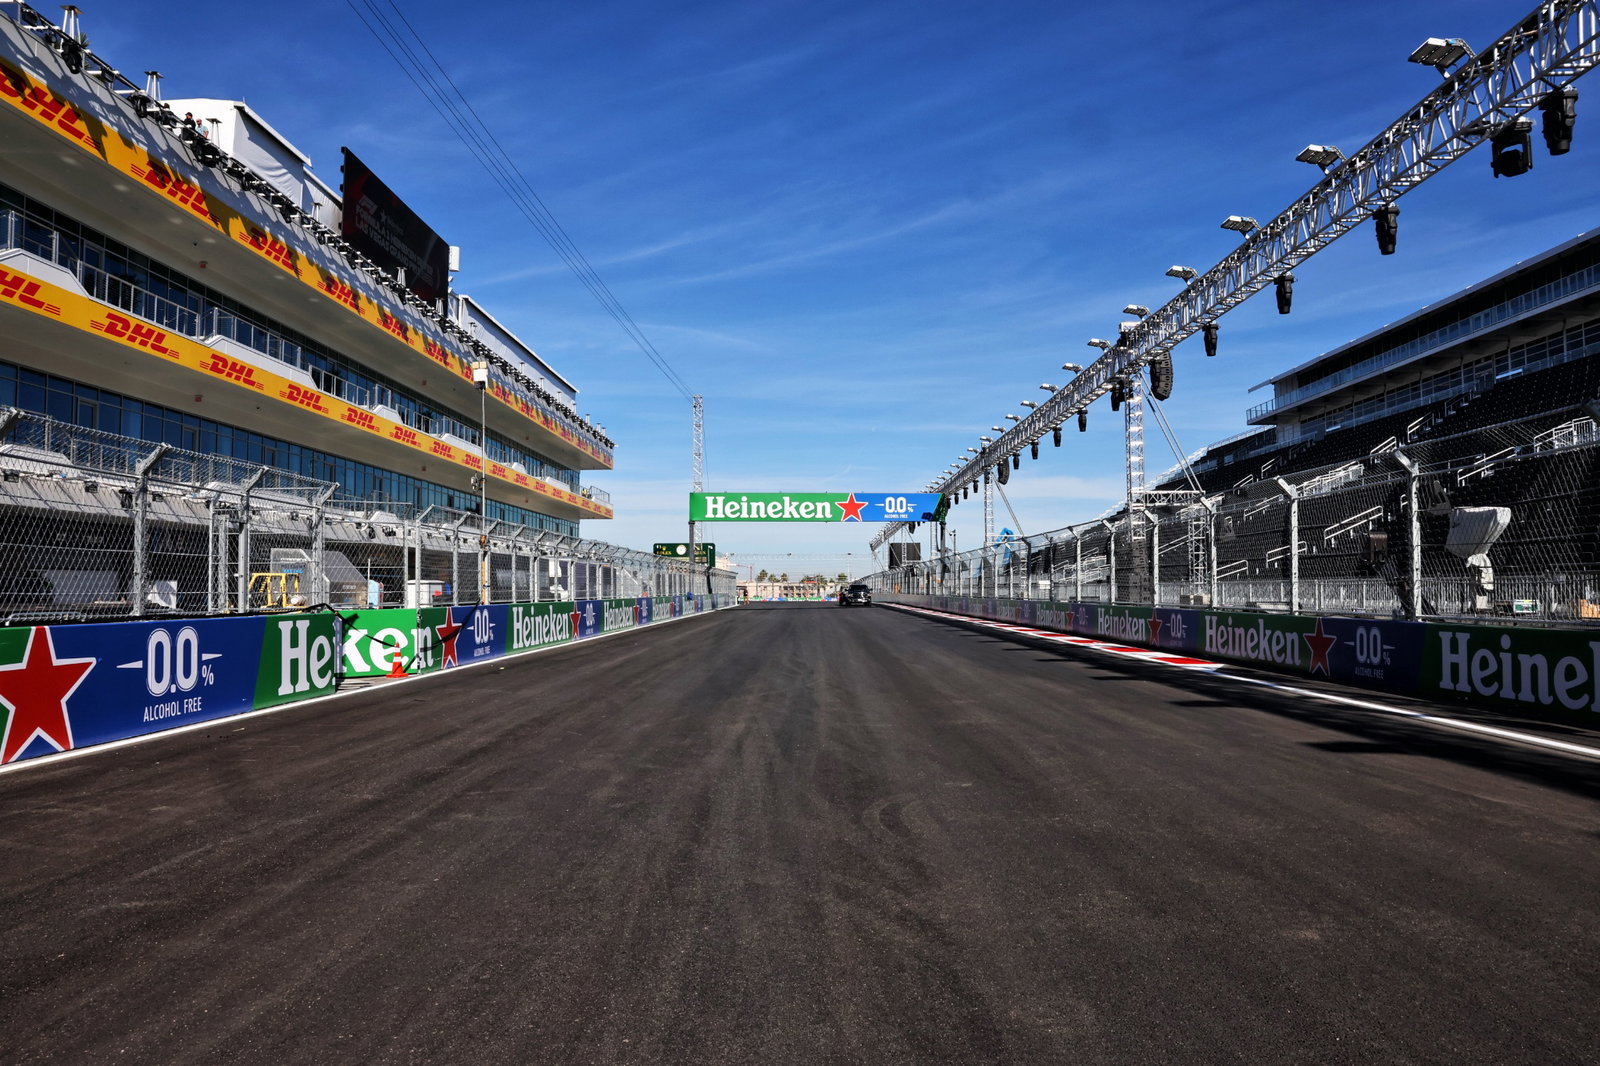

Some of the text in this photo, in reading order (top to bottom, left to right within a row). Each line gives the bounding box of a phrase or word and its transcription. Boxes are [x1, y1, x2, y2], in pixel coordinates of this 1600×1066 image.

[0, 63, 84, 140] DHL
[145, 160, 209, 217] DHL
[249, 227, 294, 270] DHL
[0, 270, 44, 309] HL
[324, 275, 359, 310] DHL
[104, 313, 169, 354] DHL
[382, 312, 408, 341] DHL
[209, 354, 256, 387] DHL
[426, 342, 449, 366] DHL
[287, 384, 322, 411] DHL
[347, 407, 375, 431] DHL
[394, 426, 417, 446] DHL
[432, 441, 452, 459] DHL
[705, 495, 832, 518] Heineken
[512, 604, 569, 649] Heineken
[1097, 608, 1145, 641] Heineken
[1204, 615, 1300, 666] Heineken
[143, 697, 202, 723] ALCOHOL FREE
